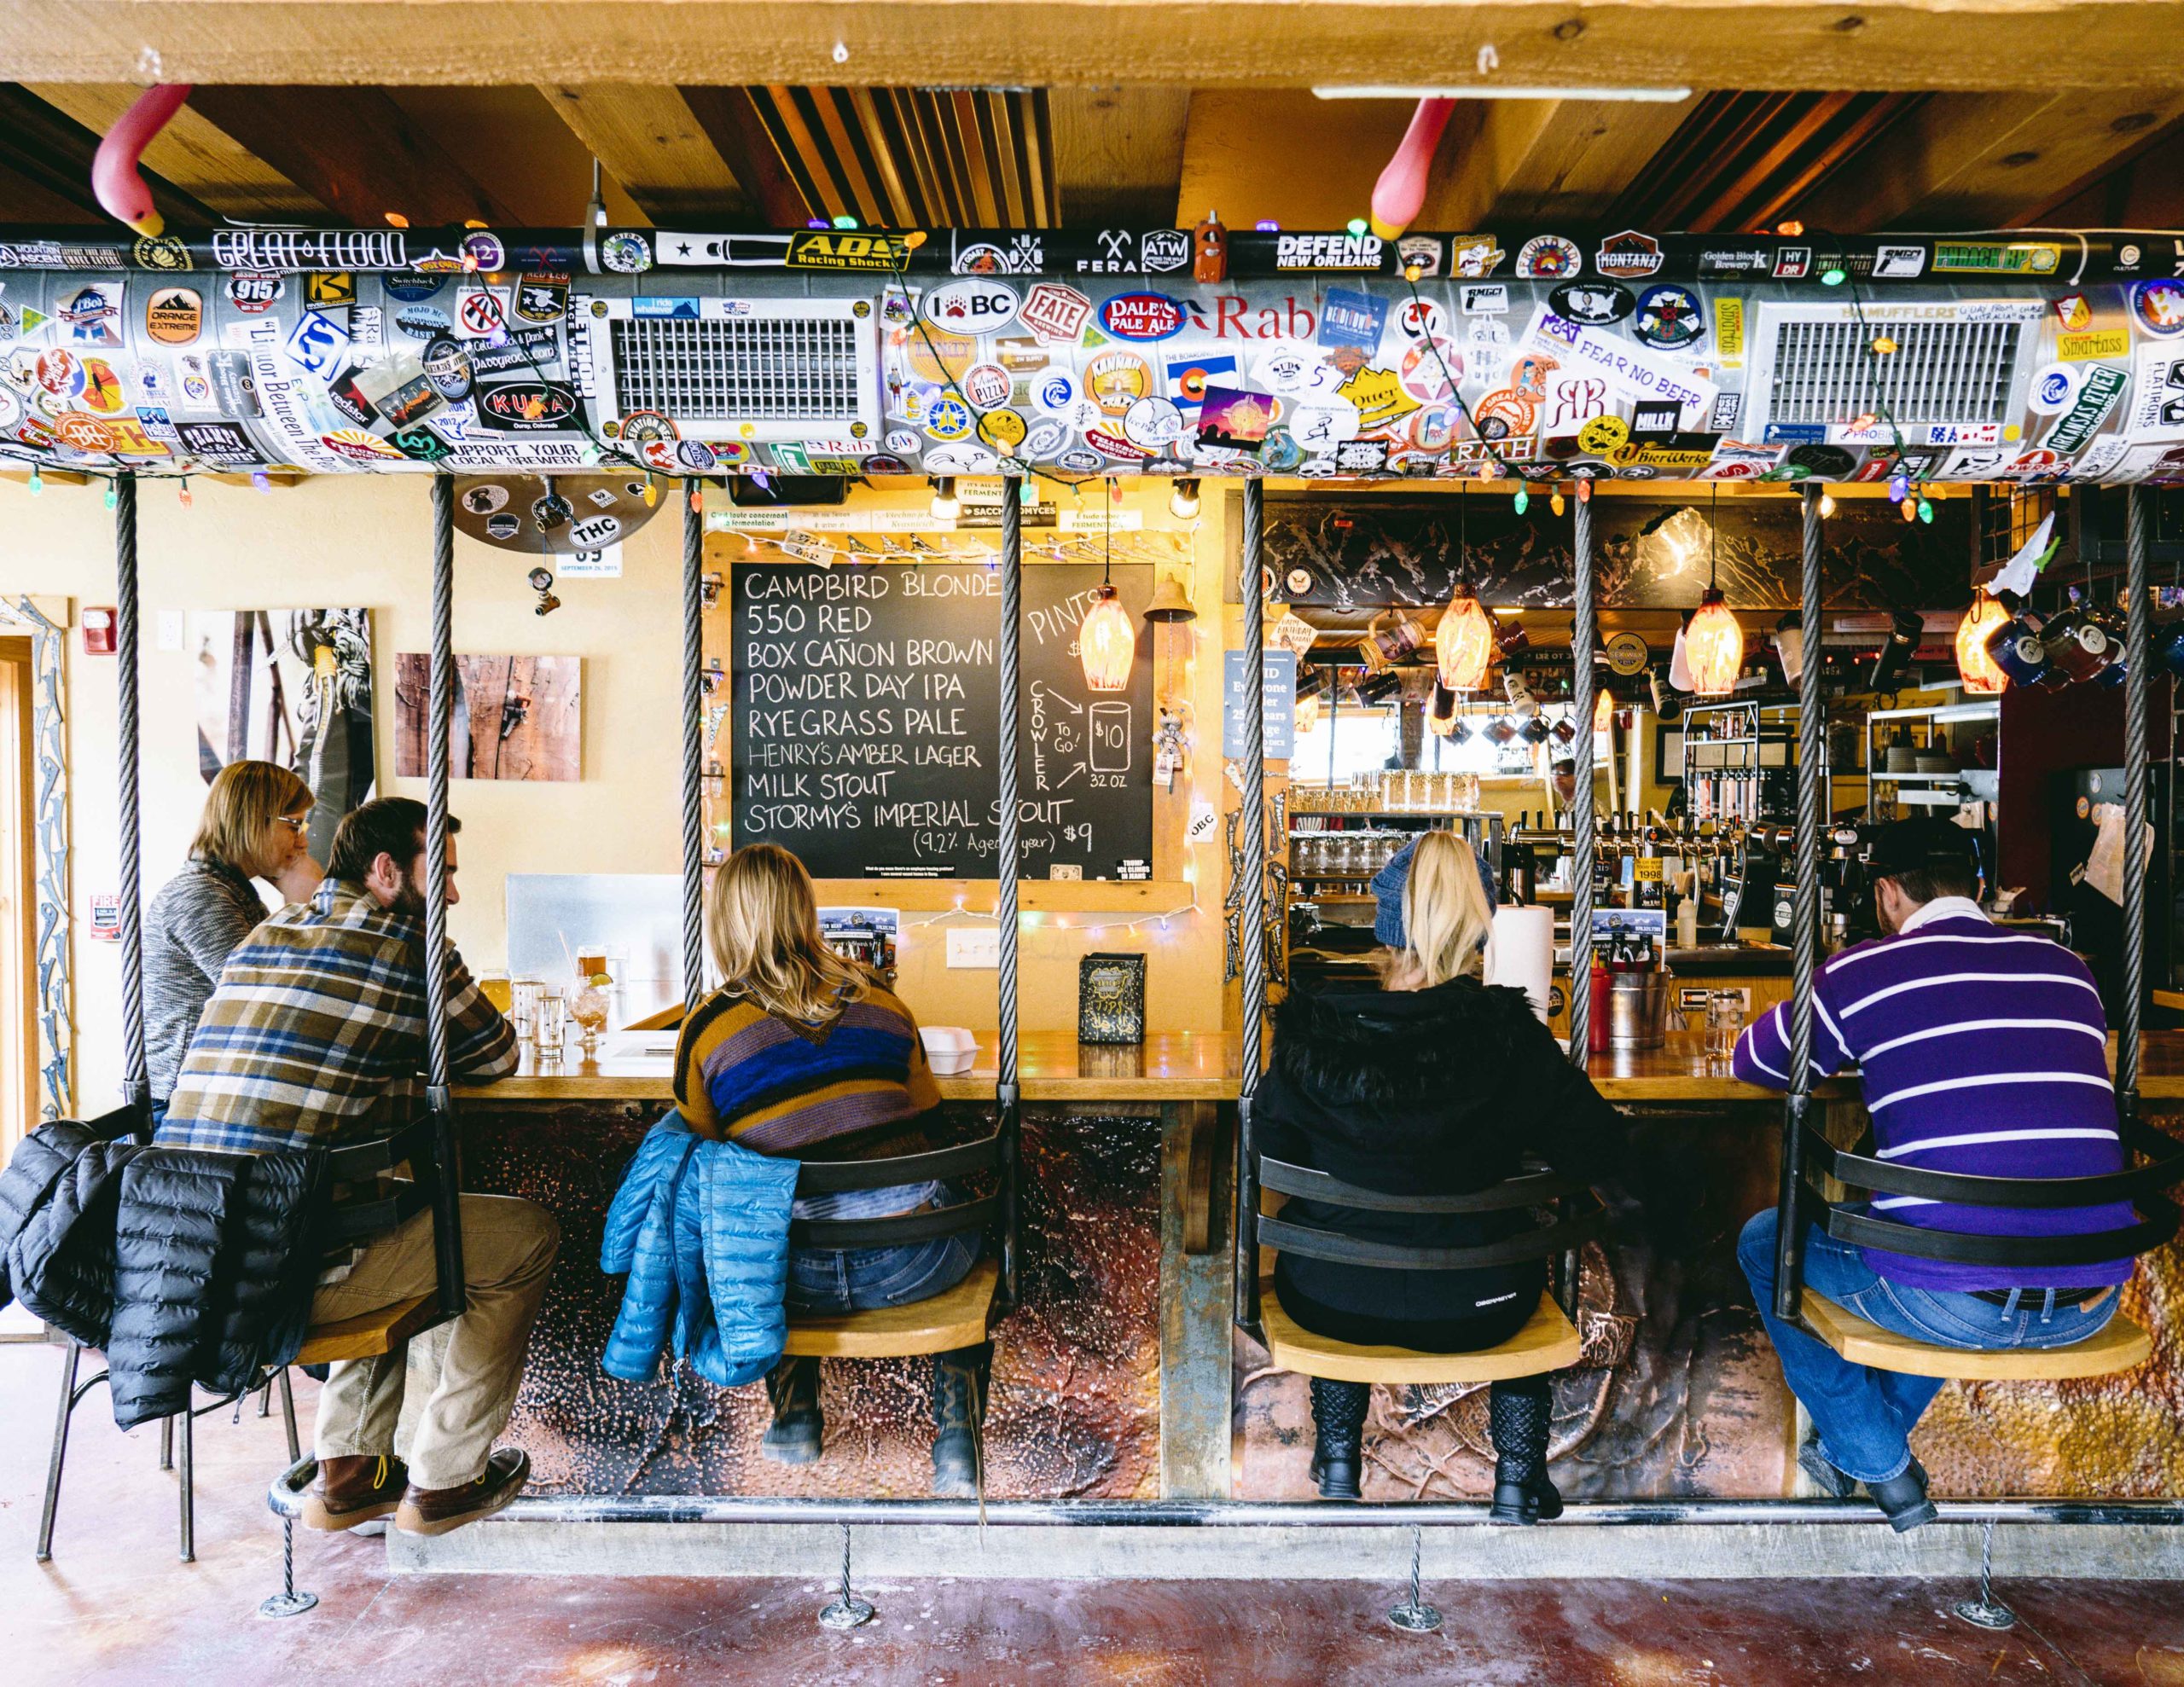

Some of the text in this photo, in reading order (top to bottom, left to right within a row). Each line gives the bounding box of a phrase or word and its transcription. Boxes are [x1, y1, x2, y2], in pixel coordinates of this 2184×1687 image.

[16, 246, 61, 255] MOUNTAIN
[212, 232, 407, 269] GREAT FLOOD
[797, 236, 904, 258] ADS
[1145, 241, 1185, 256] ATW
[1277, 235, 1383, 256] DEFEND
[20, 255, 63, 264] ASCENT
[798, 255, 845, 267] Racing
[1077, 260, 1153, 273] FERAL
[1277, 256, 1382, 267] NEW ORLEANS
[1599, 253, 1657, 269] MONTANA
[1705, 252, 1734, 261] Golden
[1714, 261, 1750, 270] Brewery
[1785, 252, 1802, 262] HY
[1781, 265, 1799, 275] DR
[237, 280, 274, 301] 915
[391, 275, 436, 287] Switchback
[407, 307, 430, 316] MOJO
[634, 305, 674, 315] whatever
[656, 299, 674, 307] ride
[971, 293, 1012, 316] BC
[1034, 291, 1078, 328] FATE
[1112, 299, 1176, 319] DALE'S
[149, 322, 197, 331] EXTREME
[151, 312, 197, 322] ORANGE
[400, 316, 447, 328] SUPPORT
[1109, 319, 1176, 333] PALE ALE
[1214, 295, 1316, 340] Rab
[1033, 318, 1064, 338] BREWING
[567, 293, 583, 398] RACE WHEELS
[2063, 334, 2123, 357] Smartass
[1310, 365, 1327, 387] 5
[1578, 341, 1629, 374] FEAR
[1629, 364, 1654, 386] NO
[1654, 377, 1702, 409] BEER
[975, 383, 1005, 403] PIZZA
[1351, 387, 1398, 407] Otter
[2143, 362, 2165, 429] FLATIRONS
[330, 390, 370, 428] redstar
[1716, 406, 1737, 415] ONLY
[1718, 399, 1739, 408] USE
[2048, 405, 2096, 451] ARKANSAS
[2081, 367, 2120, 404] RIVER
[264, 381, 305, 438] Between
[295, 438, 322, 455] The
[2082, 393, 2117, 439] COLORADO
[514, 422, 532, 431] Ouray,
[452, 443, 579, 457] UPPORT YOUR
[828, 440, 872, 454] Rab
[1090, 432, 1147, 458] TELLURIDE
[449, 456, 582, 466] LOCAL BREWERY
[731, 519, 776, 528] fermentation
[749, 511, 788, 519] concernant
[573, 517, 617, 543] THC
[745, 571, 1003, 600] CAMPBIRD BLONDE
[747, 604, 872, 635] 550 RED
[747, 637, 993, 669] BOX CAÑON BROWN
[1267, 667, 1281, 680] ID
[749, 672, 966, 704] POWDER DAY IPA
[1233, 681, 1288, 694] Evone
[904, 708, 967, 736] PALE
[1030, 679, 1050, 791] CROWLER
[1095, 720, 1124, 749] $10
[747, 740, 982, 768] HENRY'S AMBER LAGER
[747, 770, 896, 800] MILK STOUT
[1089, 774, 1128, 788] 32 OZ
[744, 798, 1075, 833] STORMY'S IMPERIAL SOUT
[1190, 814, 1215, 838] OBC
[1063, 822, 1093, 853] $9
[1639, 870, 1662, 879] 1998
[94, 896, 120, 907] FIRE
